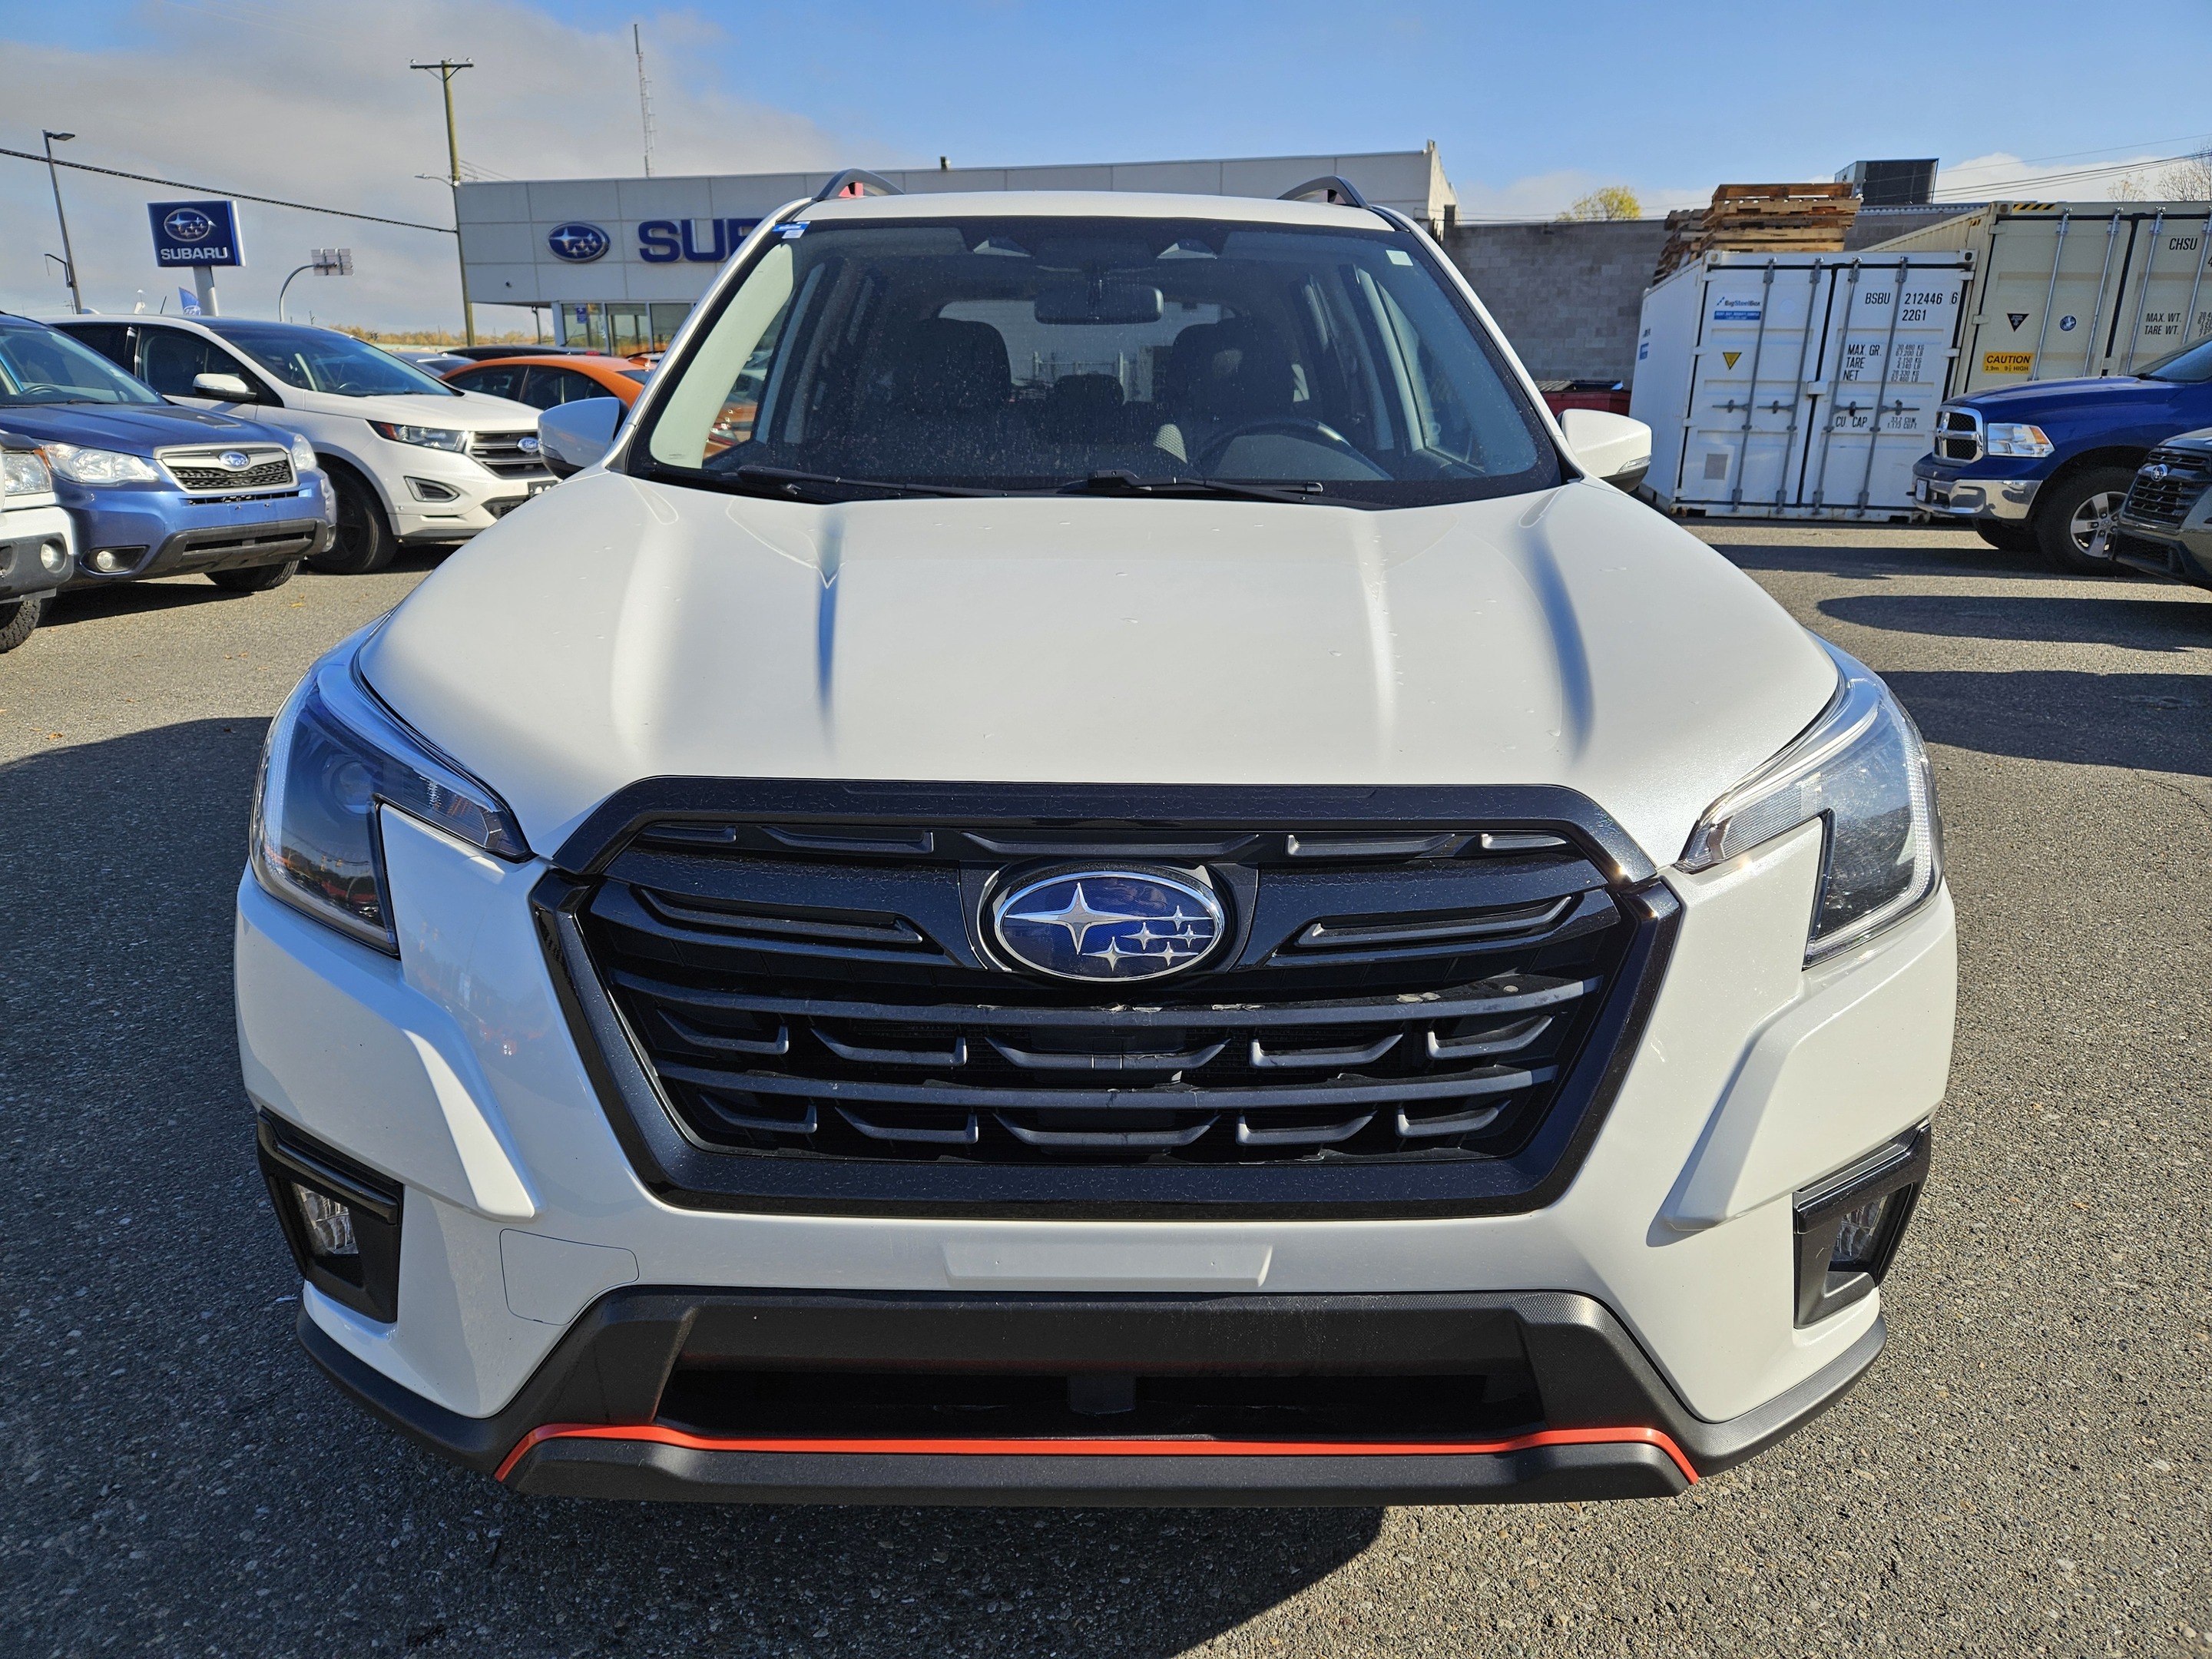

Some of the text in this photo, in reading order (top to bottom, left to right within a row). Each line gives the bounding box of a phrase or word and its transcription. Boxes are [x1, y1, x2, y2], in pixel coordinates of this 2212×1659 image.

[2169, 237, 2198, 250] CHSU
[160, 247, 229, 260] SUBARU
[1865, 292, 1959, 305] BSBU 212446 6
[1902, 309, 1927, 321] 22G1
[2146, 313, 2182, 323] MAX. WT.
[2144, 325, 2180, 336] TARE WT.
[1847, 344, 1882, 356] MAX. GR.
[1846, 357, 1866, 369] TARE
[1986, 355, 2031, 364] CAUTION
[1843, 369, 1860, 381] NET
